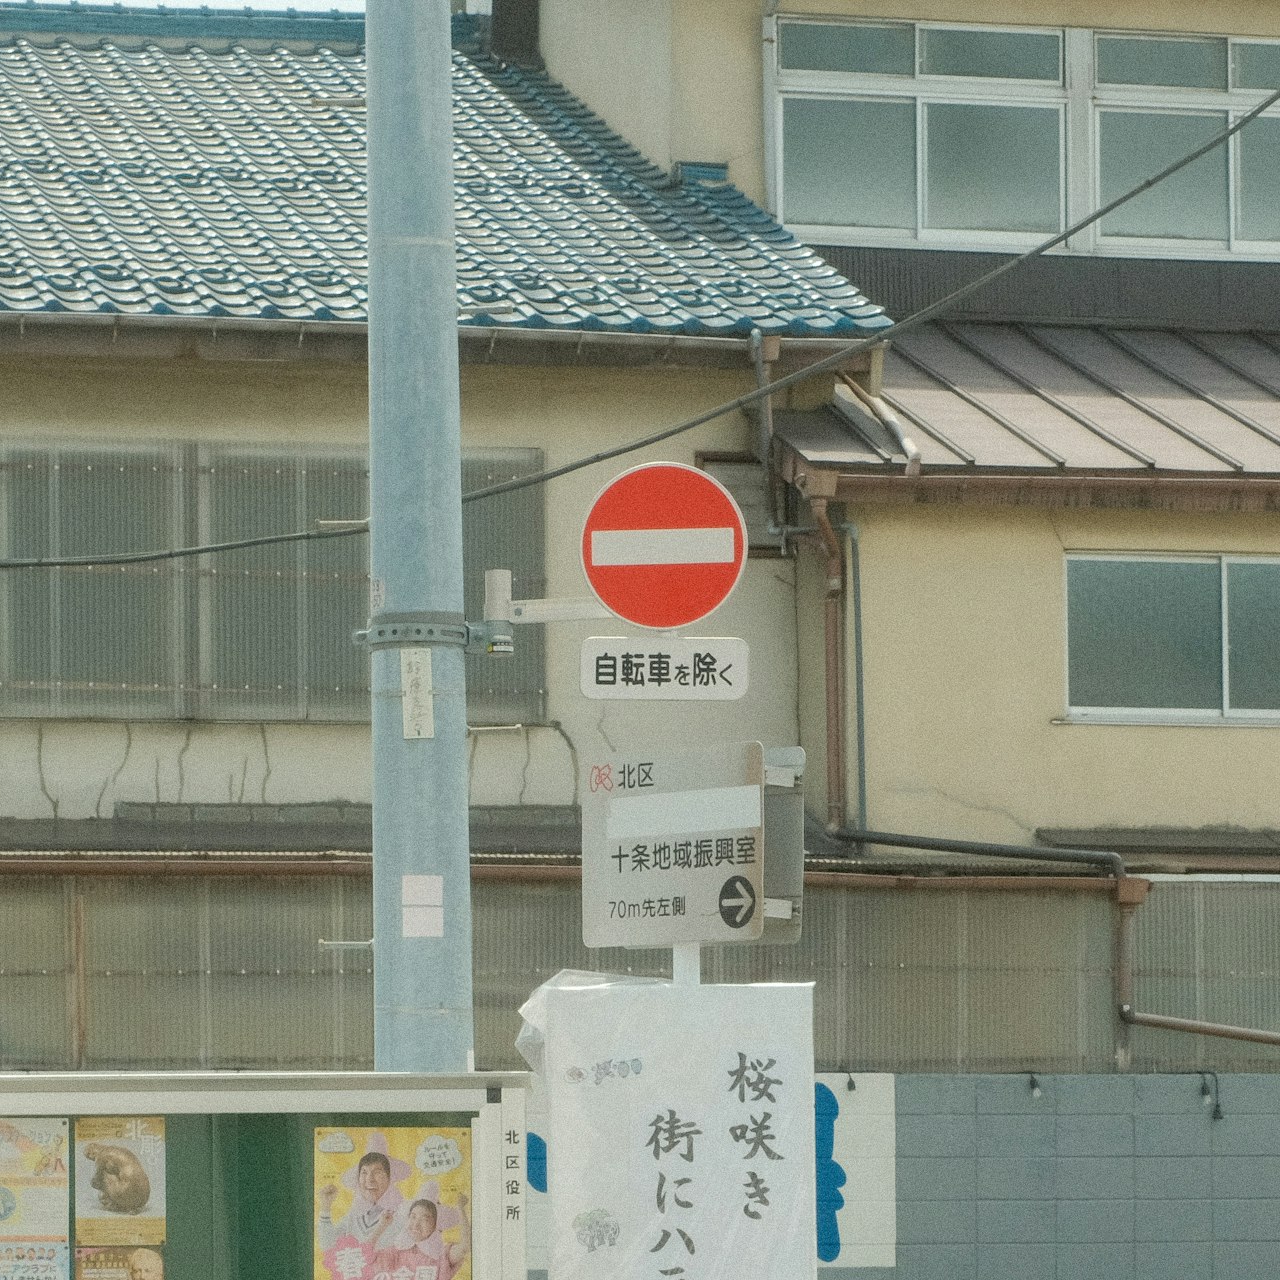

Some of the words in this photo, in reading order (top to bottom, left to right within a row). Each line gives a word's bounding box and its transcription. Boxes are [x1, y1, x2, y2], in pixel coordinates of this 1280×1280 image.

[594, 652, 734, 687] 自転車を除く
[617, 762, 655, 789] 北区
[611, 836, 756, 874] 十条地域振興室
[608, 895, 687, 918] 70m先左側
[728, 1051, 785, 1220] 桜咲き
[505, 1129, 521, 1221] 北区役所
